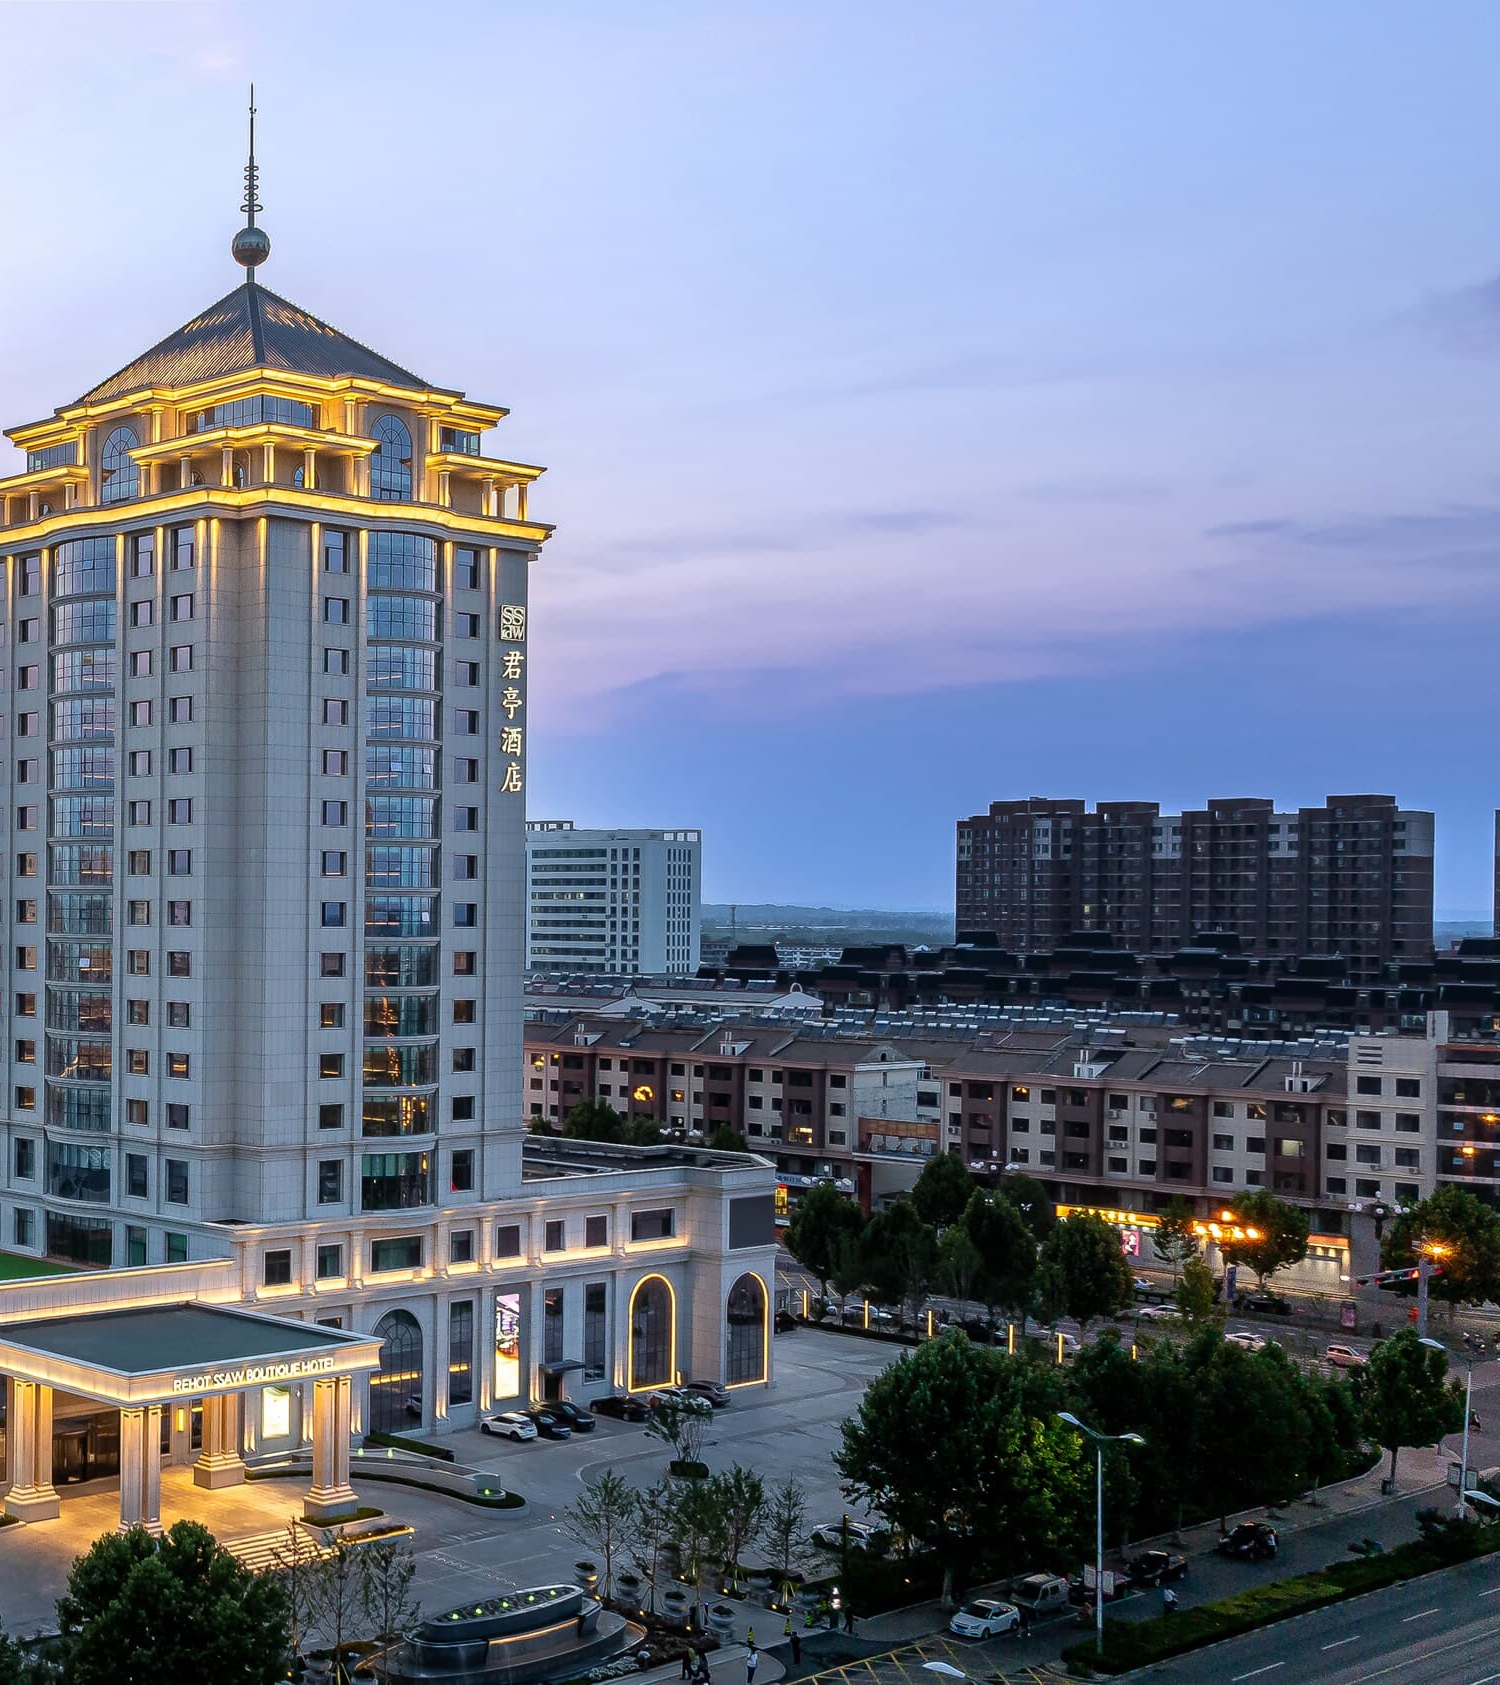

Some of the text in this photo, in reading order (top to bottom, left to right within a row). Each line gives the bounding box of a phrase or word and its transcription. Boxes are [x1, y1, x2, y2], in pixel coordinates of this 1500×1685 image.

[501, 650, 525, 793] 君亭酒店
[173, 1357, 334, 1392] REHOT SSAW BOUTIQUE HOTEL
